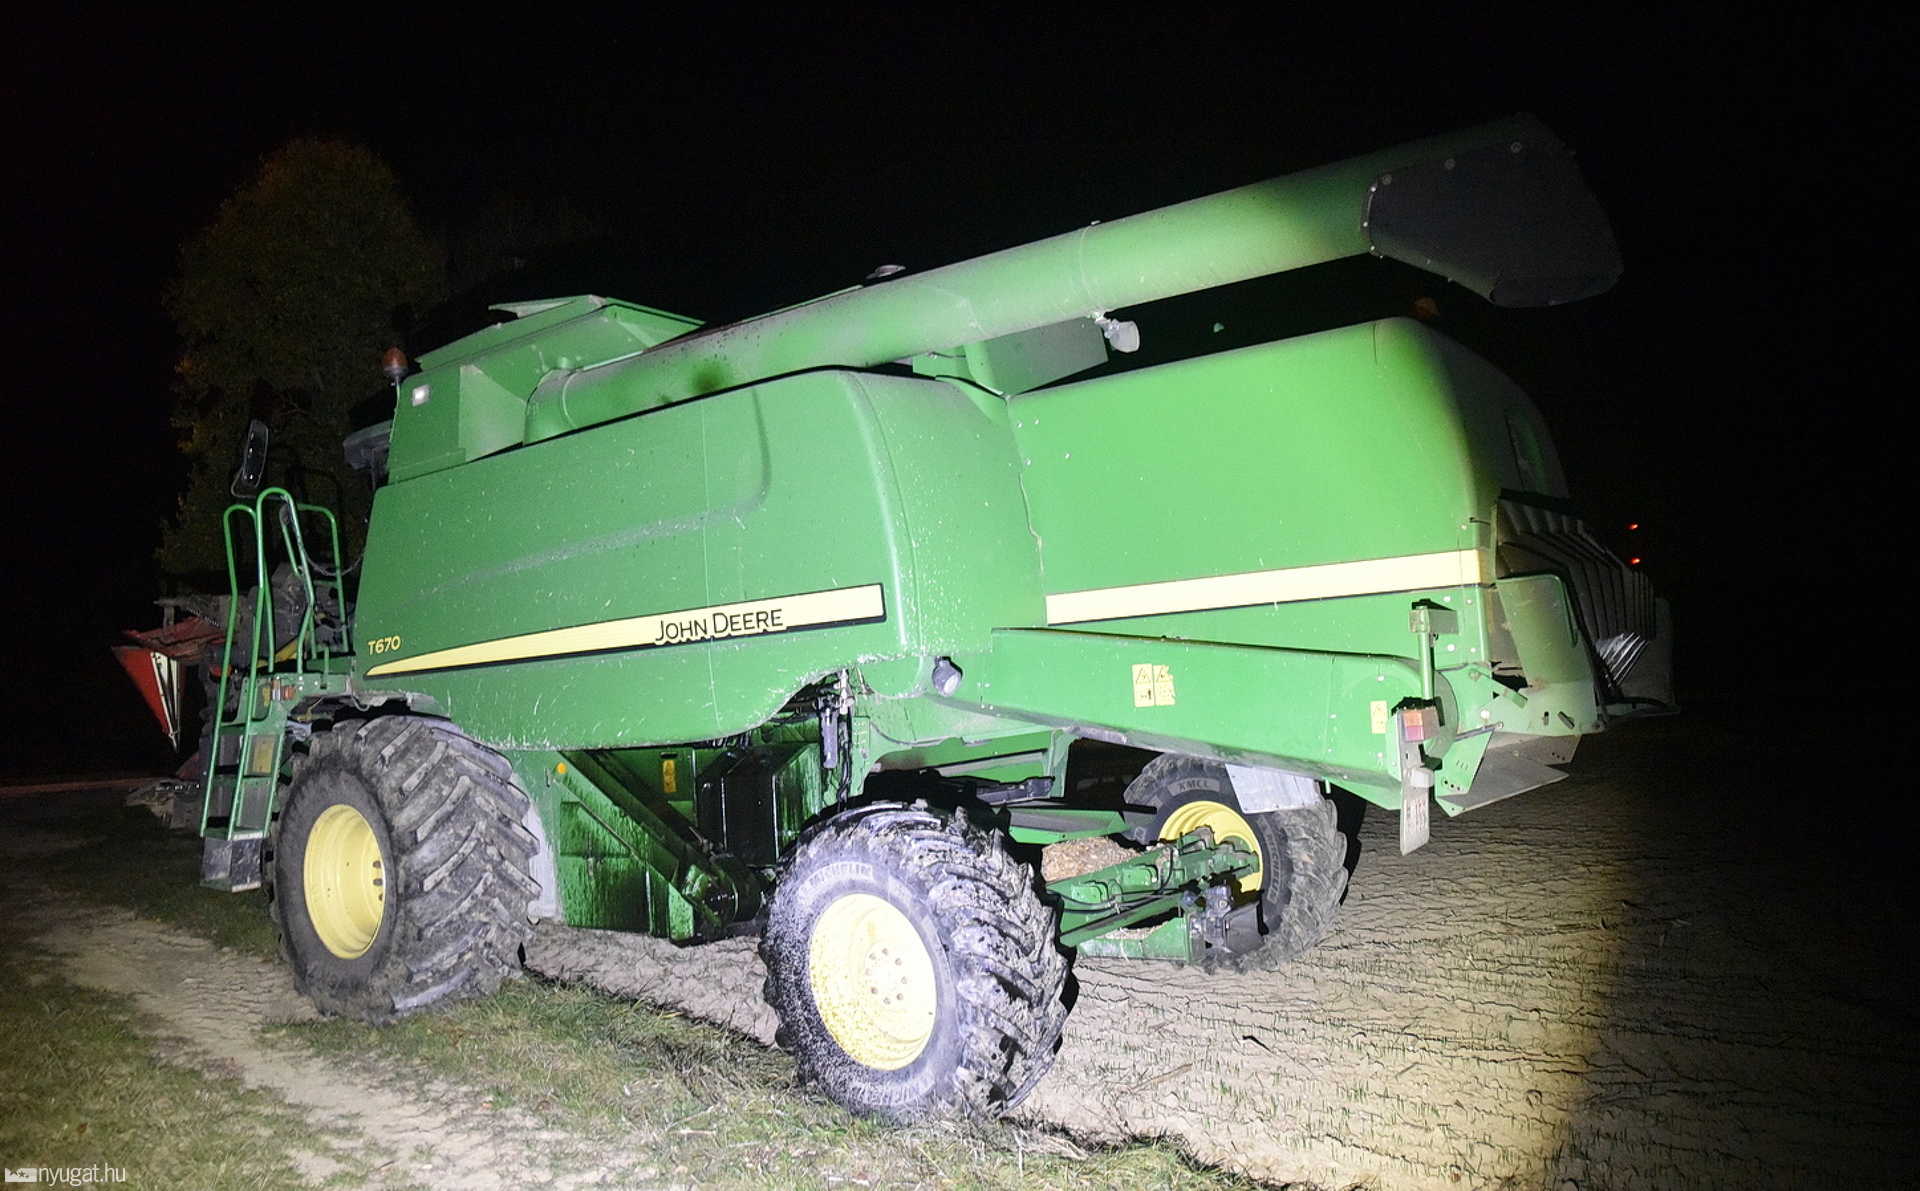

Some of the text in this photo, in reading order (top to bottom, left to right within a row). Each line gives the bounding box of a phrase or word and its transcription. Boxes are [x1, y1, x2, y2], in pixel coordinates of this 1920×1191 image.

[655, 608, 784, 642] JOHN DEERE
[367, 635, 401, 656] T670
